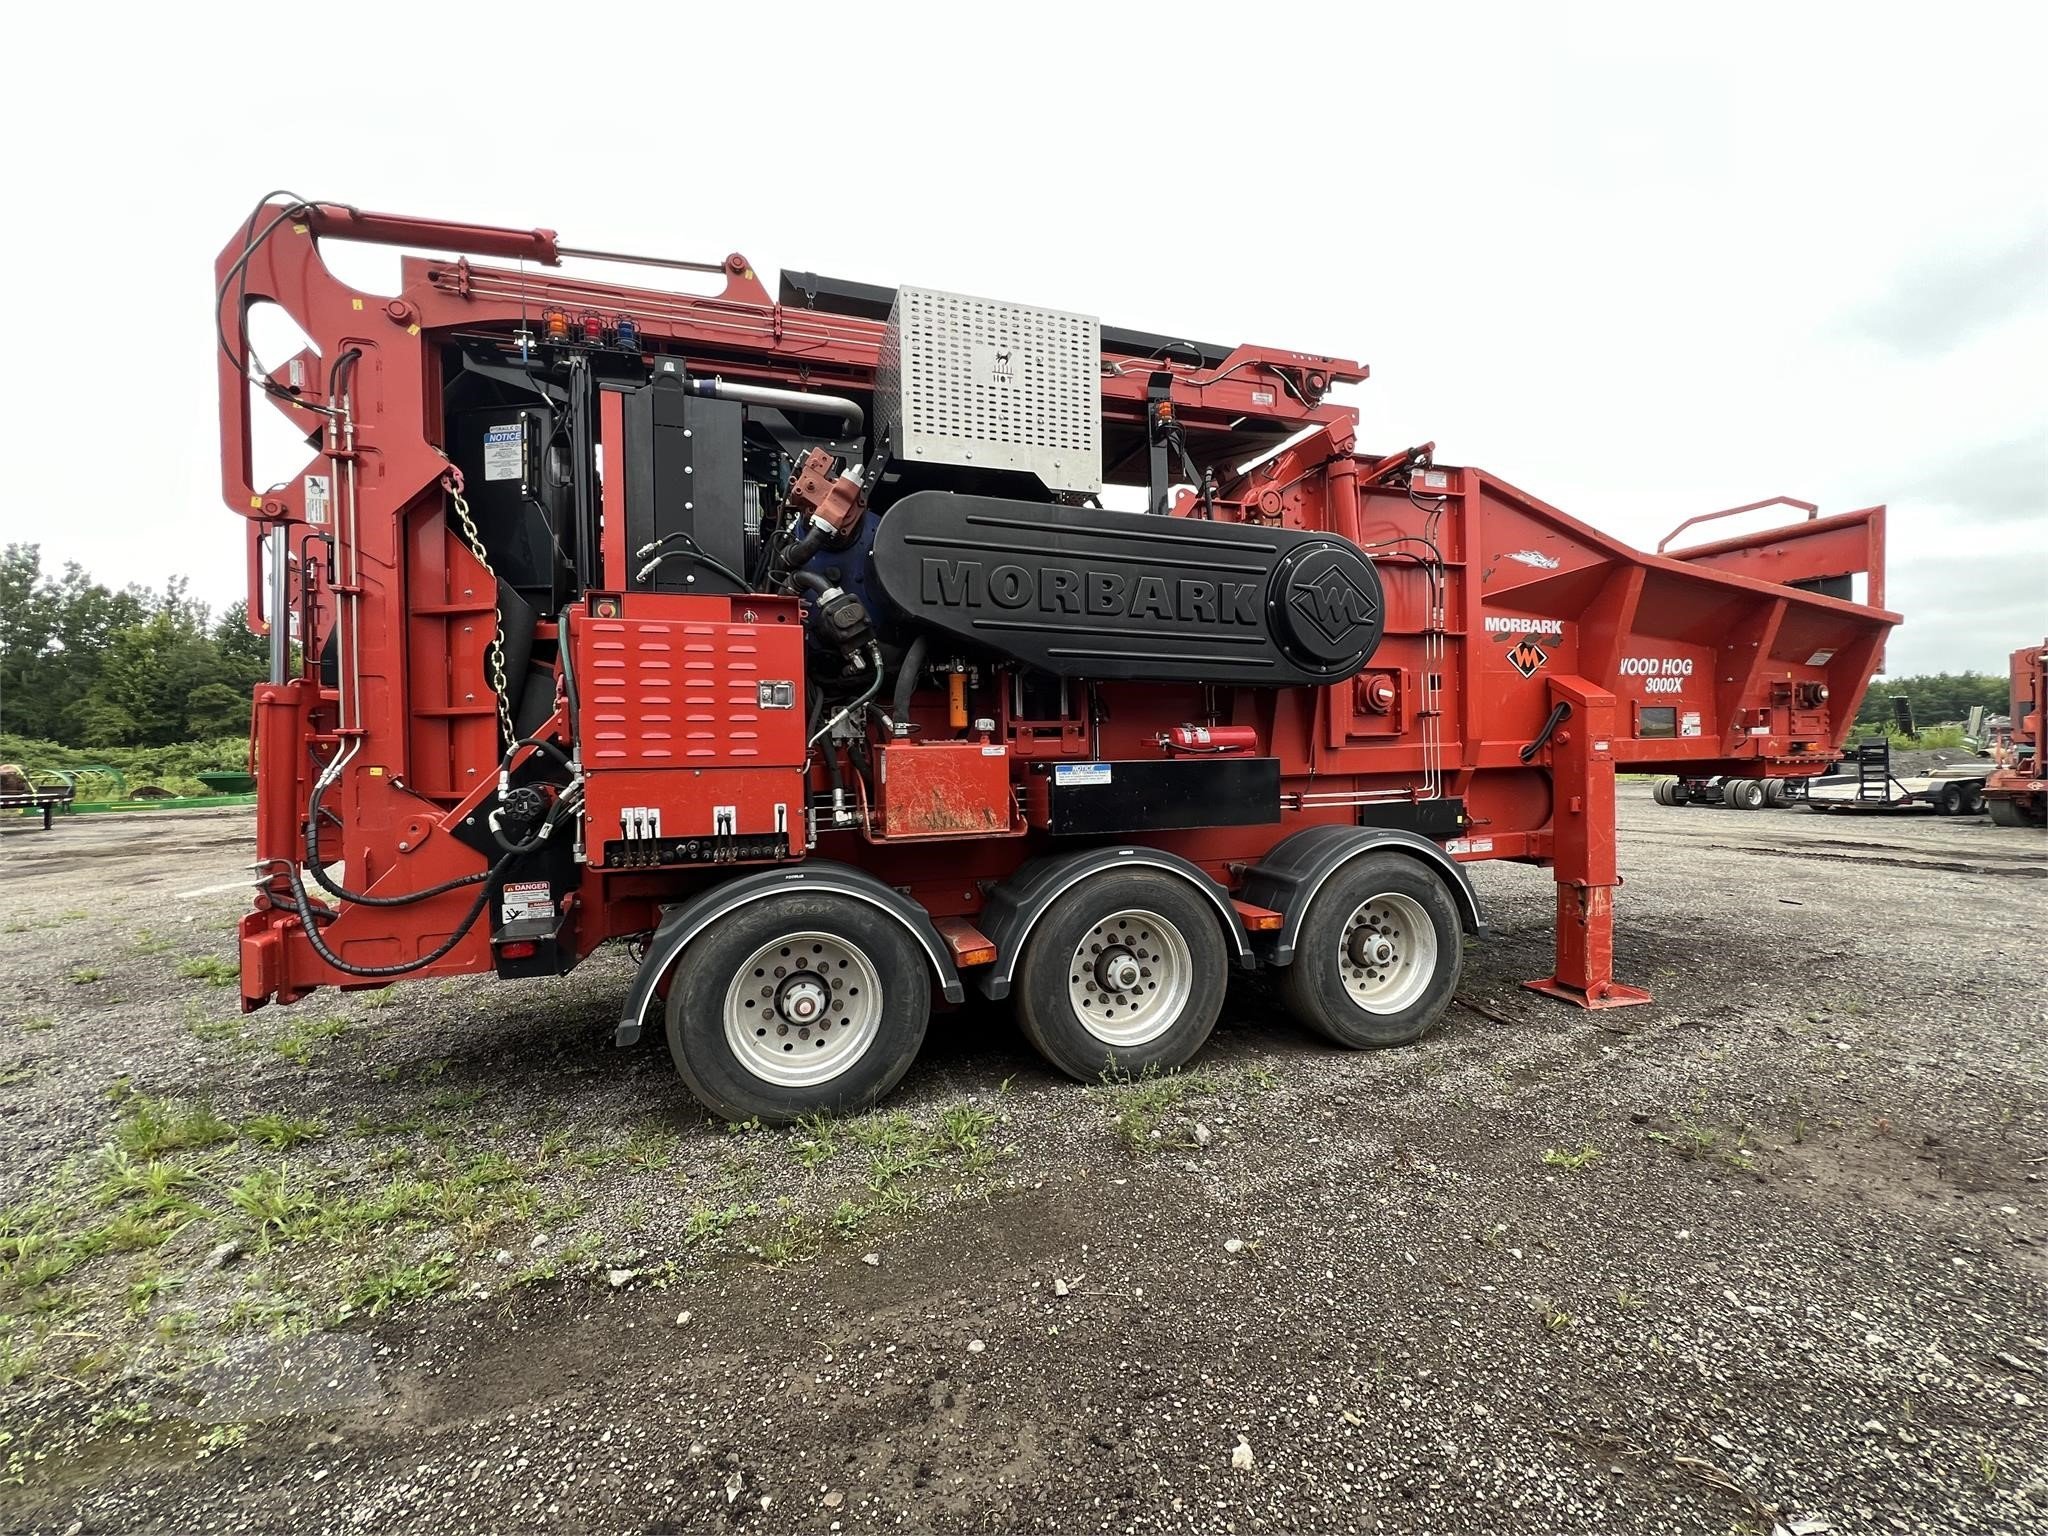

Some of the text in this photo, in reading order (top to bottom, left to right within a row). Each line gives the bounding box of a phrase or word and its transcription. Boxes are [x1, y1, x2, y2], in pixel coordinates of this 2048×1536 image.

[489, 432, 520, 441] NOTICE
[921, 558, 1258, 626] MORBARK
[1484, 617, 1562, 634] MORBARK
[1661, 658, 1694, 676] HOG
[1645, 677, 1684, 694] 3000X
